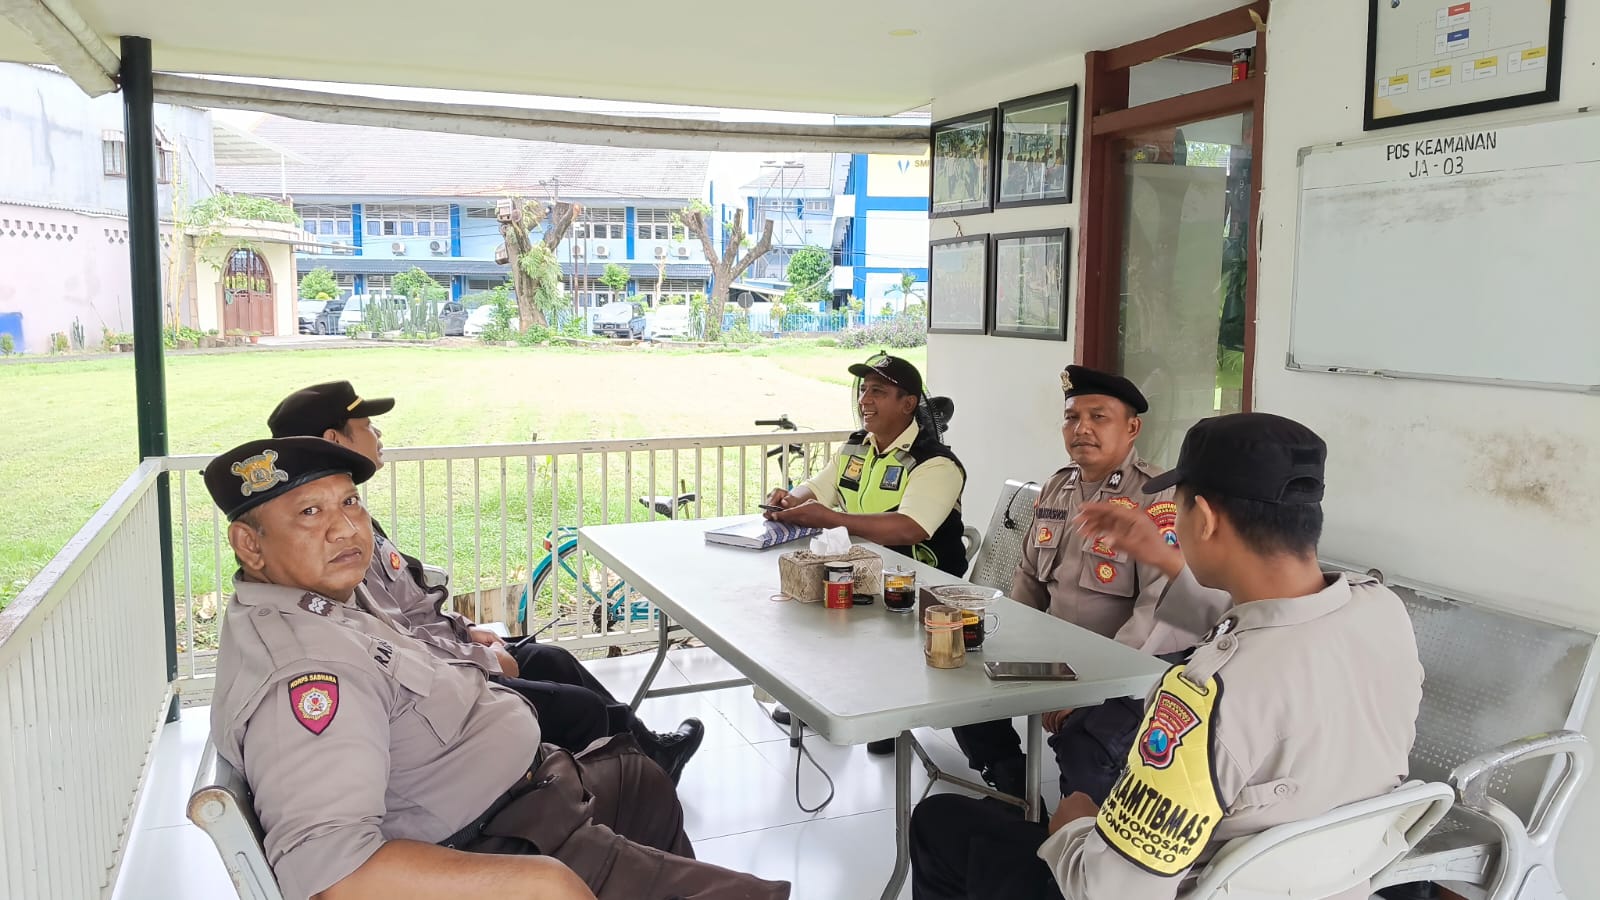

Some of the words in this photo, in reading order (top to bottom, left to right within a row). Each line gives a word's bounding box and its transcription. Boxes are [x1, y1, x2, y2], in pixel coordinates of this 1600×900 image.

[1386, 143, 1410, 161] POS
[1415, 131, 1497, 156] KEAMANAN
[1408, 159, 1429, 178] JA
[1443, 156, 1464, 175] 03
[290, 675, 308, 688] KORPS
[309, 673, 337, 684] SABHARA
[1118, 810, 1192, 856] WONOSARI
